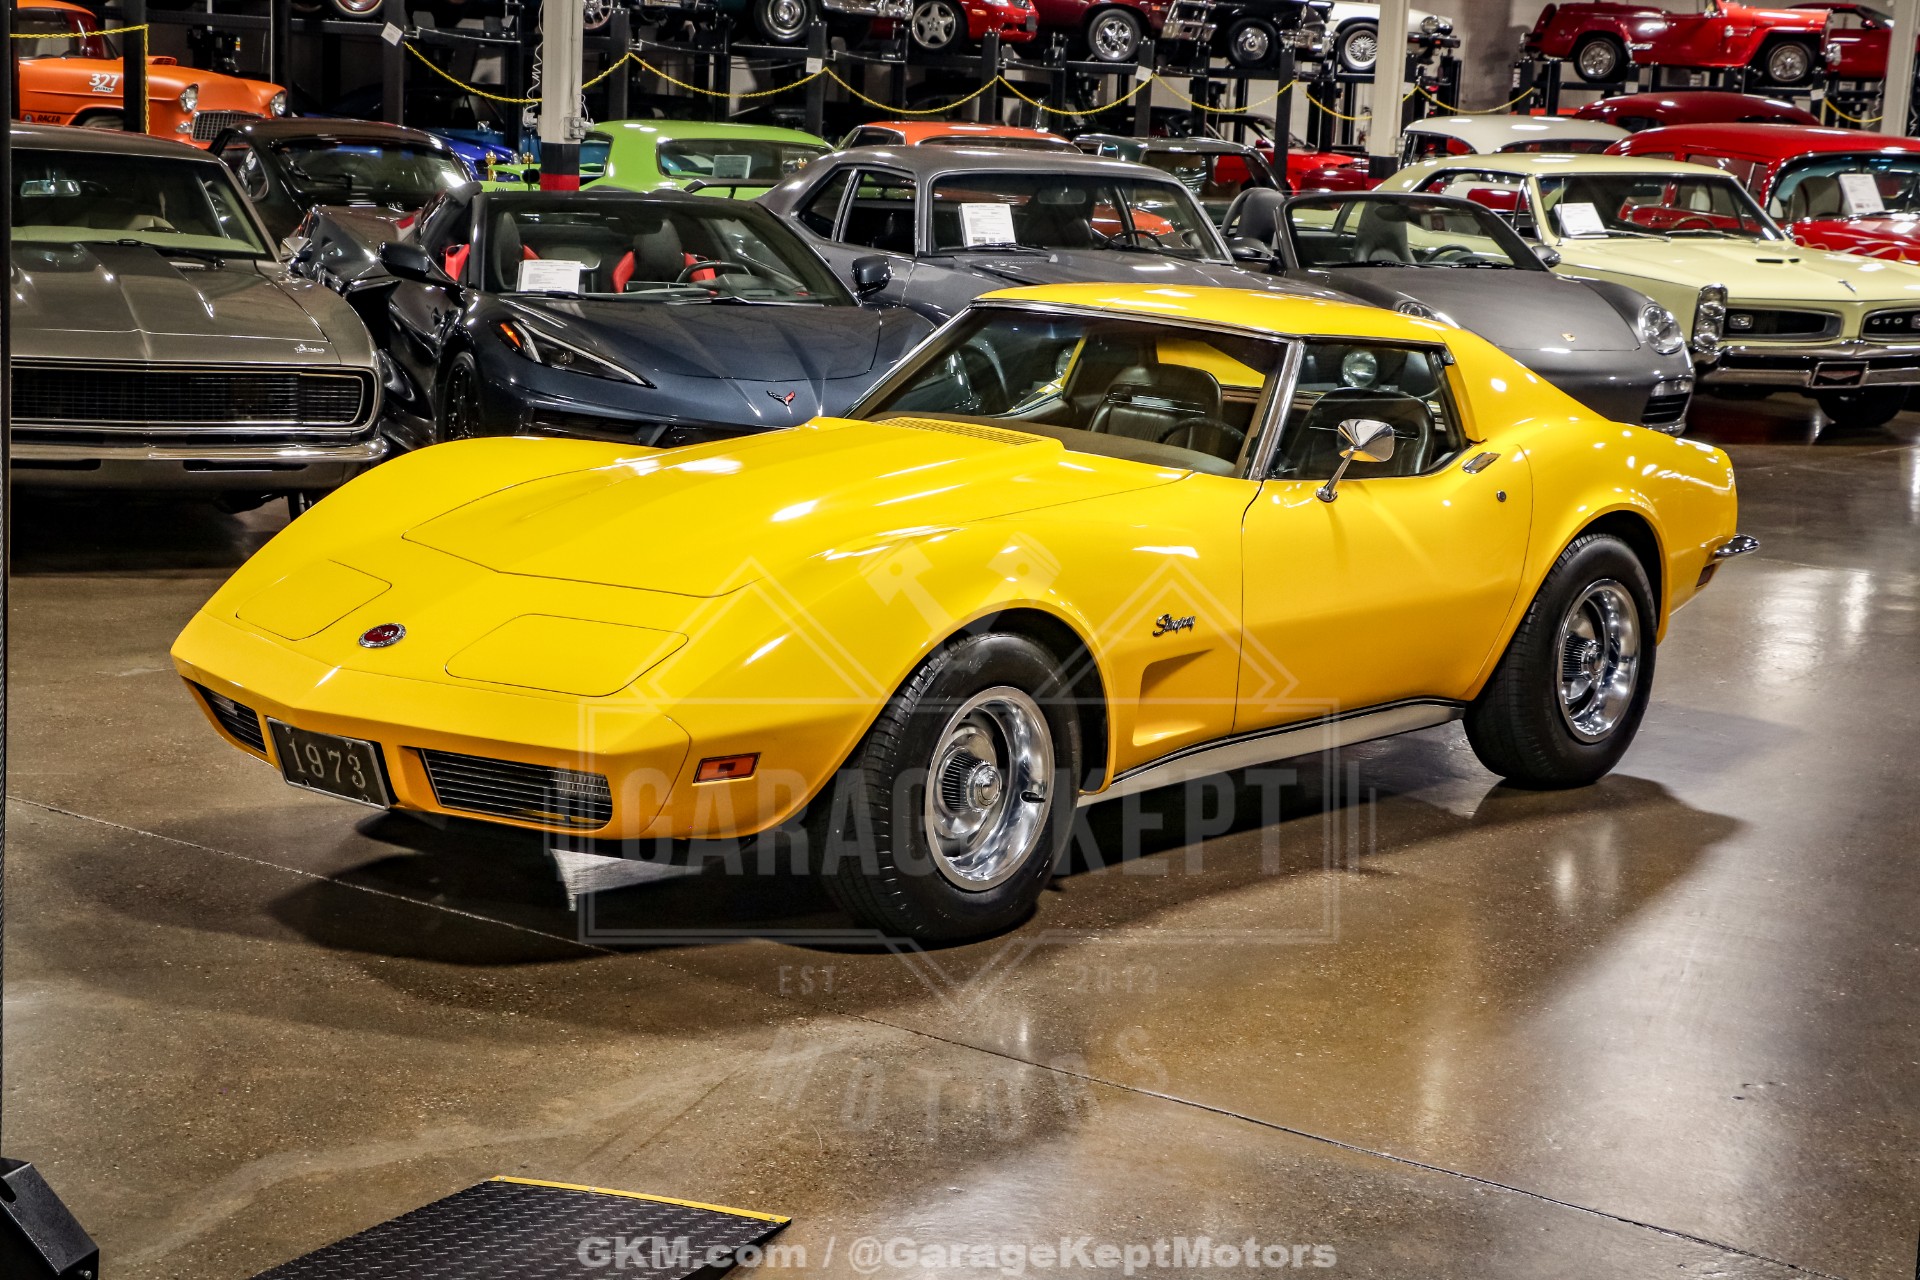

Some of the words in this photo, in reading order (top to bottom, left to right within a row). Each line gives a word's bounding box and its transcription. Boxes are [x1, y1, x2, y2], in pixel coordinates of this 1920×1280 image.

[88, 73, 119, 87] 327
[37, 114, 61, 124] RACER
[1871, 317, 1904, 326] GTO
[289, 738, 366, 789] 1973
